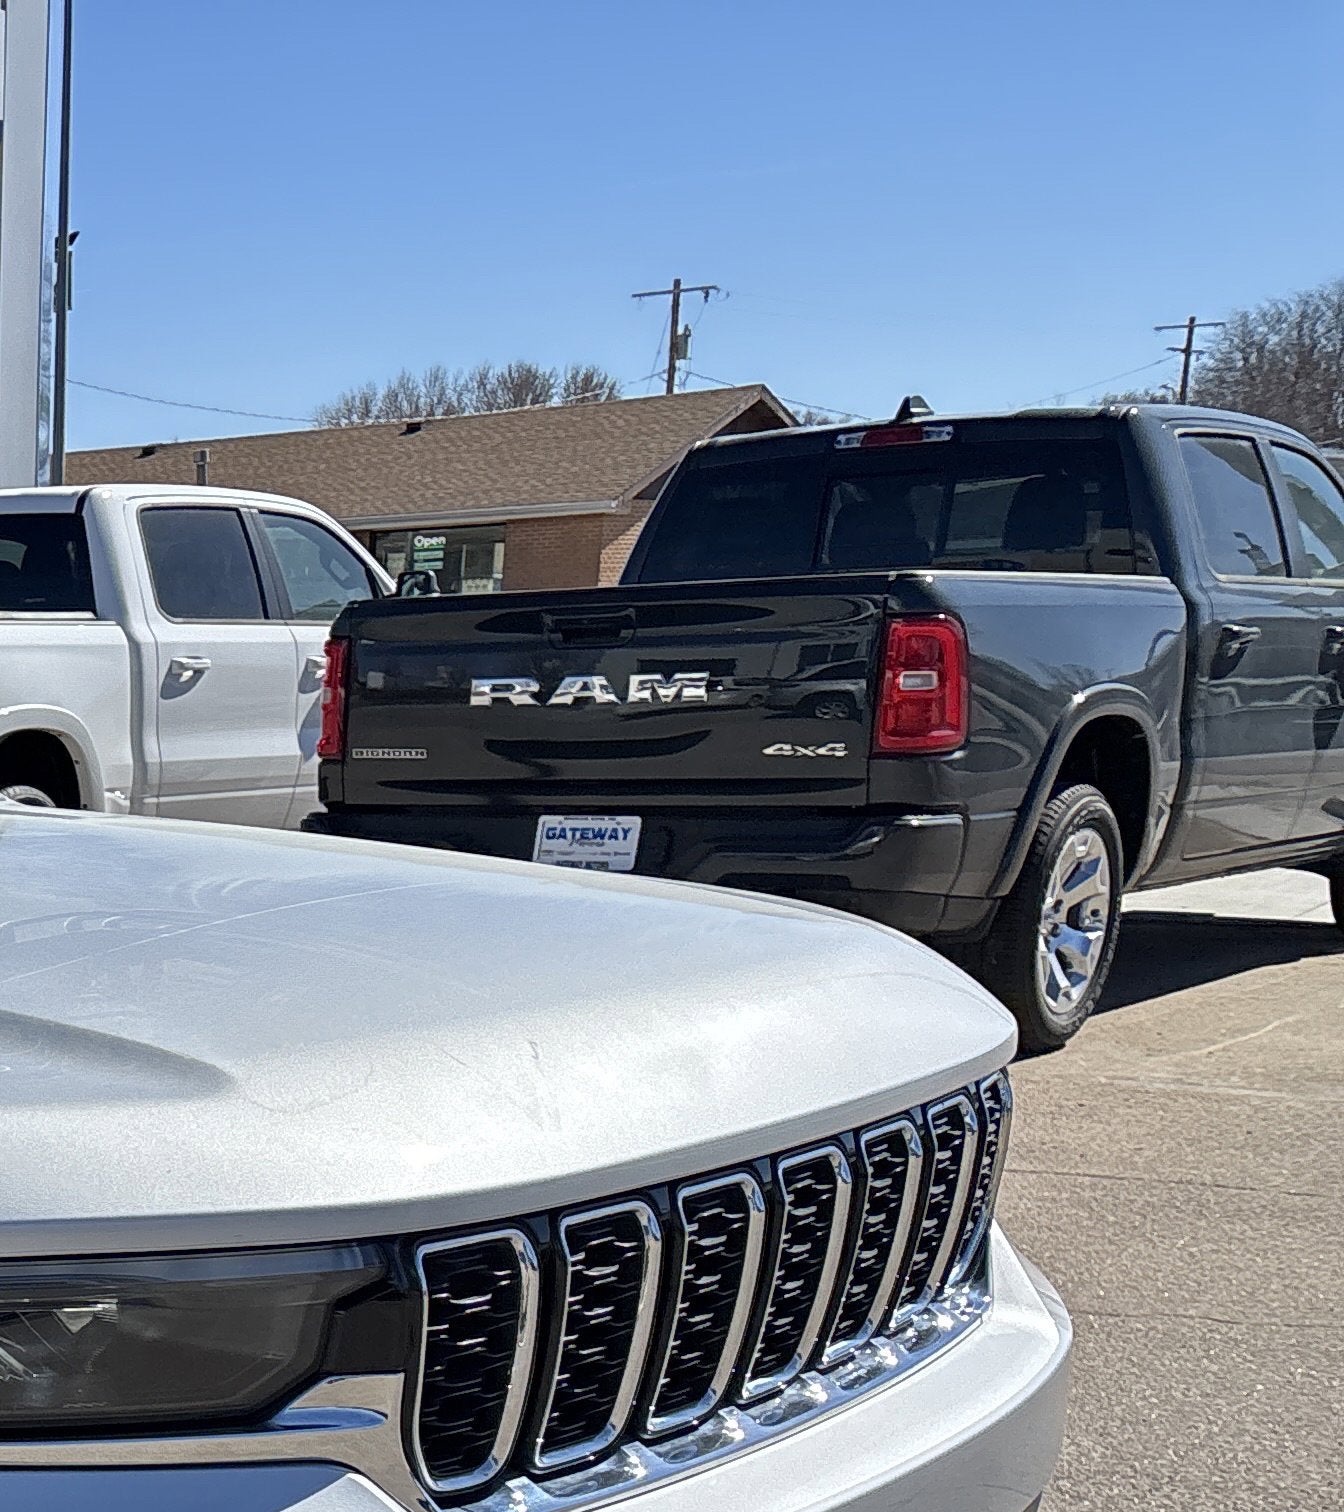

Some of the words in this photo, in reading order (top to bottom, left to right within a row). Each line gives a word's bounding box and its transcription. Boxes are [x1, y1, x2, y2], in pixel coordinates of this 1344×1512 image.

[414, 535, 447, 549] Open
[469, 671, 710, 706] RAM
[761, 742, 849, 758] 4x4
[545, 826, 633, 841] GATEWAY
